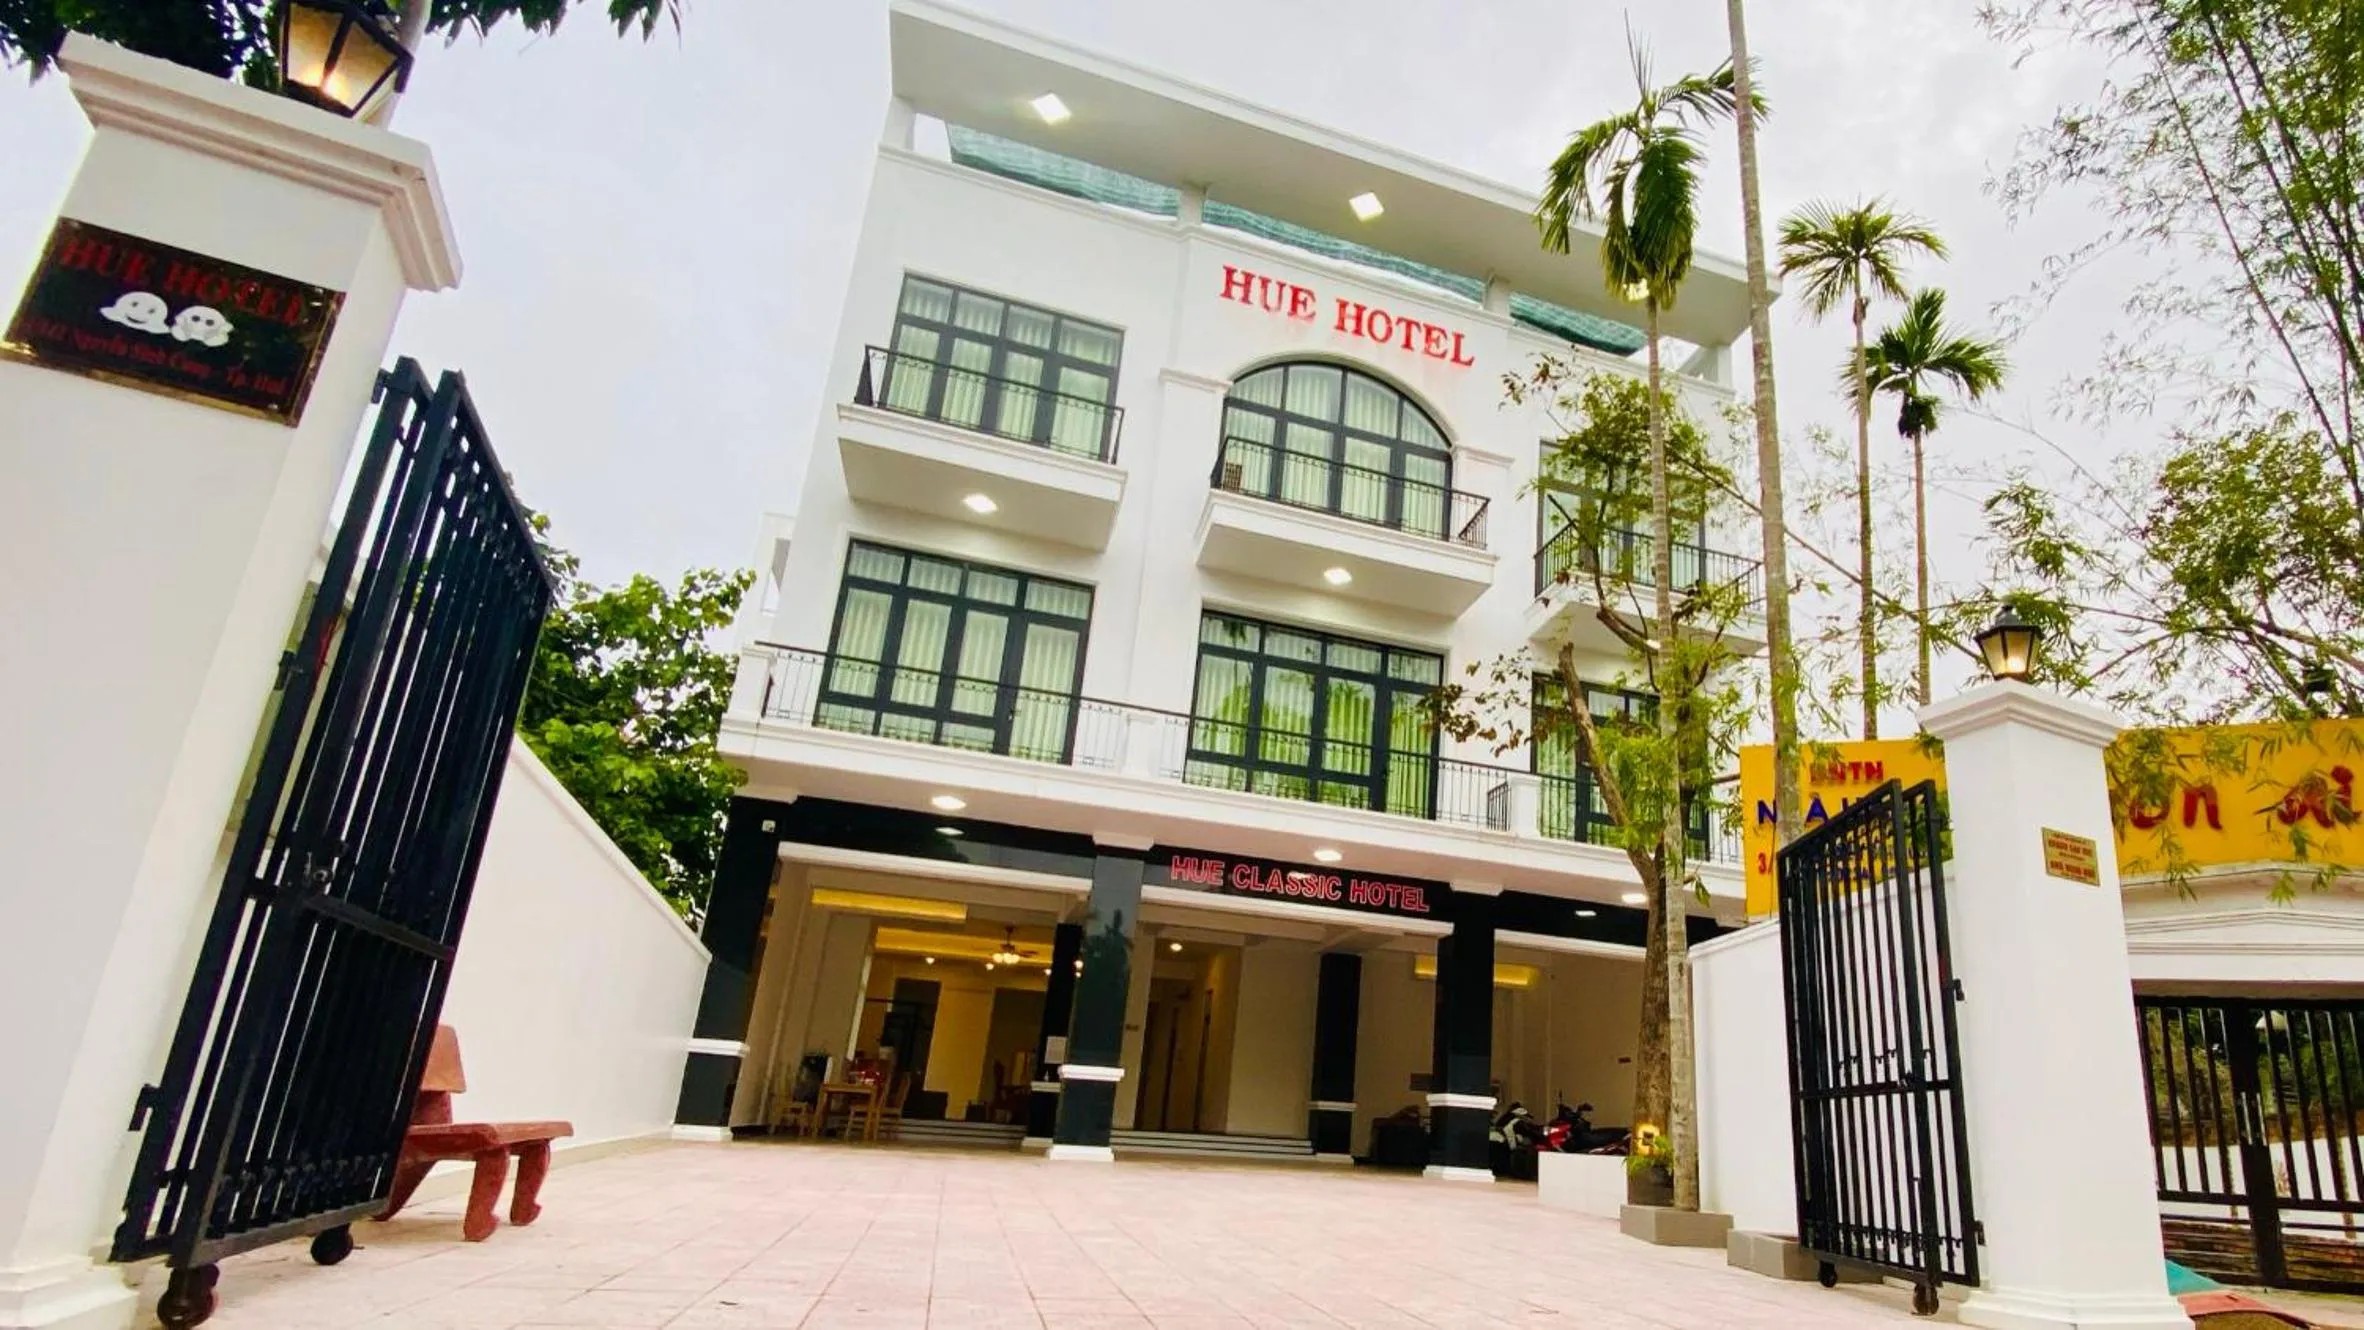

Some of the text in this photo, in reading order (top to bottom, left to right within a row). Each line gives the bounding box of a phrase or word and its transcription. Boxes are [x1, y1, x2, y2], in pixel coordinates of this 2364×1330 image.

[62, 238, 154, 286] HUE
[1220, 264, 1475, 368] HUE HOTEL
[1171, 855, 1431, 912] HUE CLASSIC HOTEL
